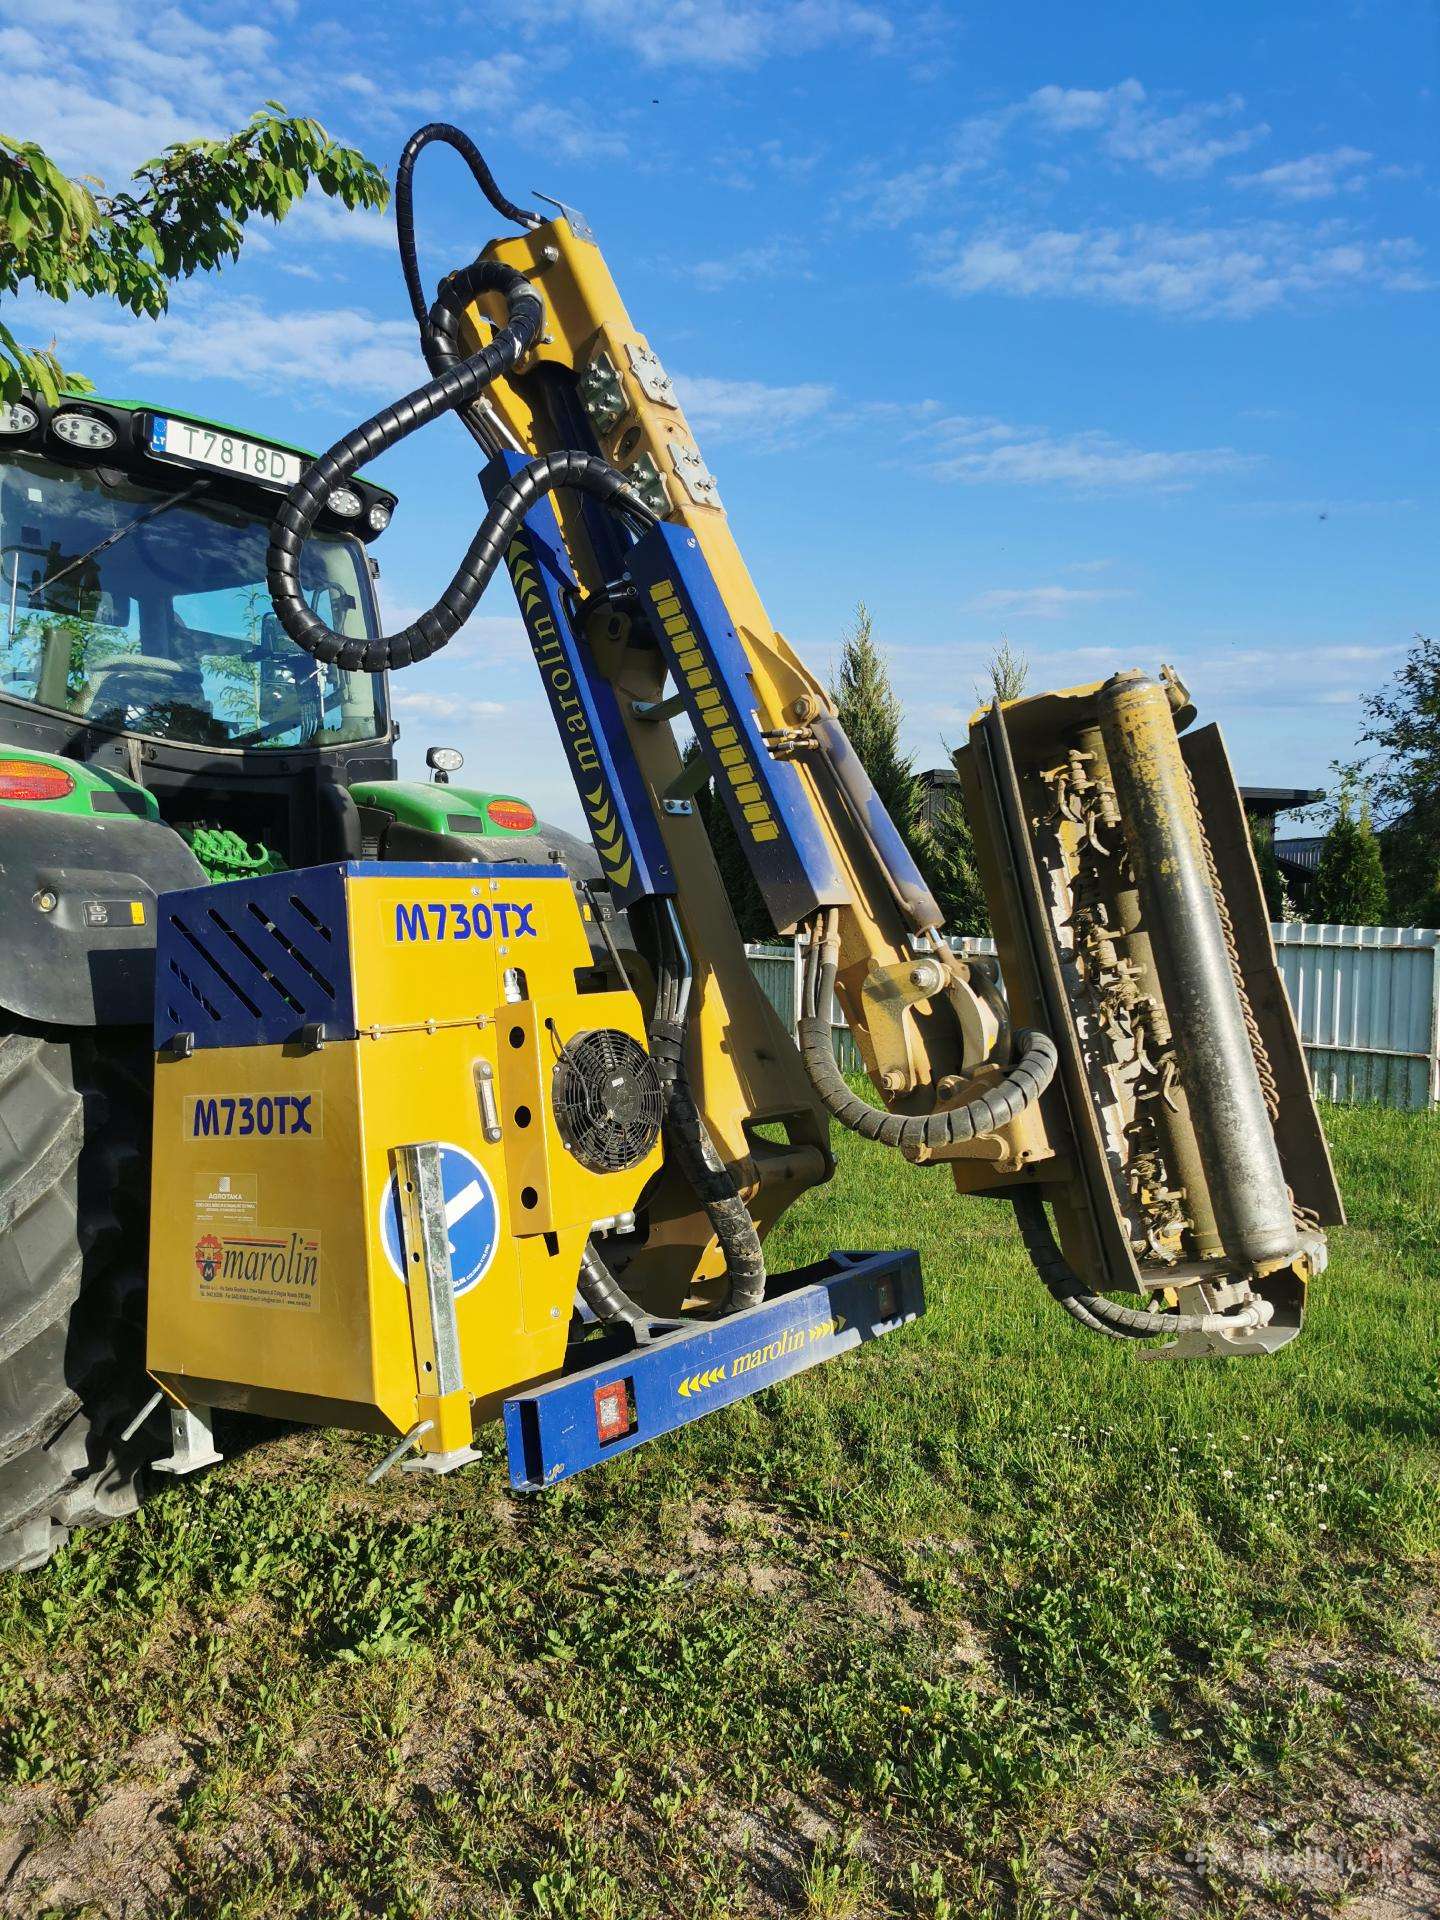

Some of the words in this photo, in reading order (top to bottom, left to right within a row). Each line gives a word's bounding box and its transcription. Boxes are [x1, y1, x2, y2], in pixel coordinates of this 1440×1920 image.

[152, 435, 166, 445] LT
[184, 426, 286, 478] T7818D
[534, 614, 600, 773] marolin
[395, 903, 538, 942] M730TX
[193, 1095, 312, 1137] M730TX
[222, 1232, 318, 1286] marolin
[731, 1328, 804, 1377] marolin
